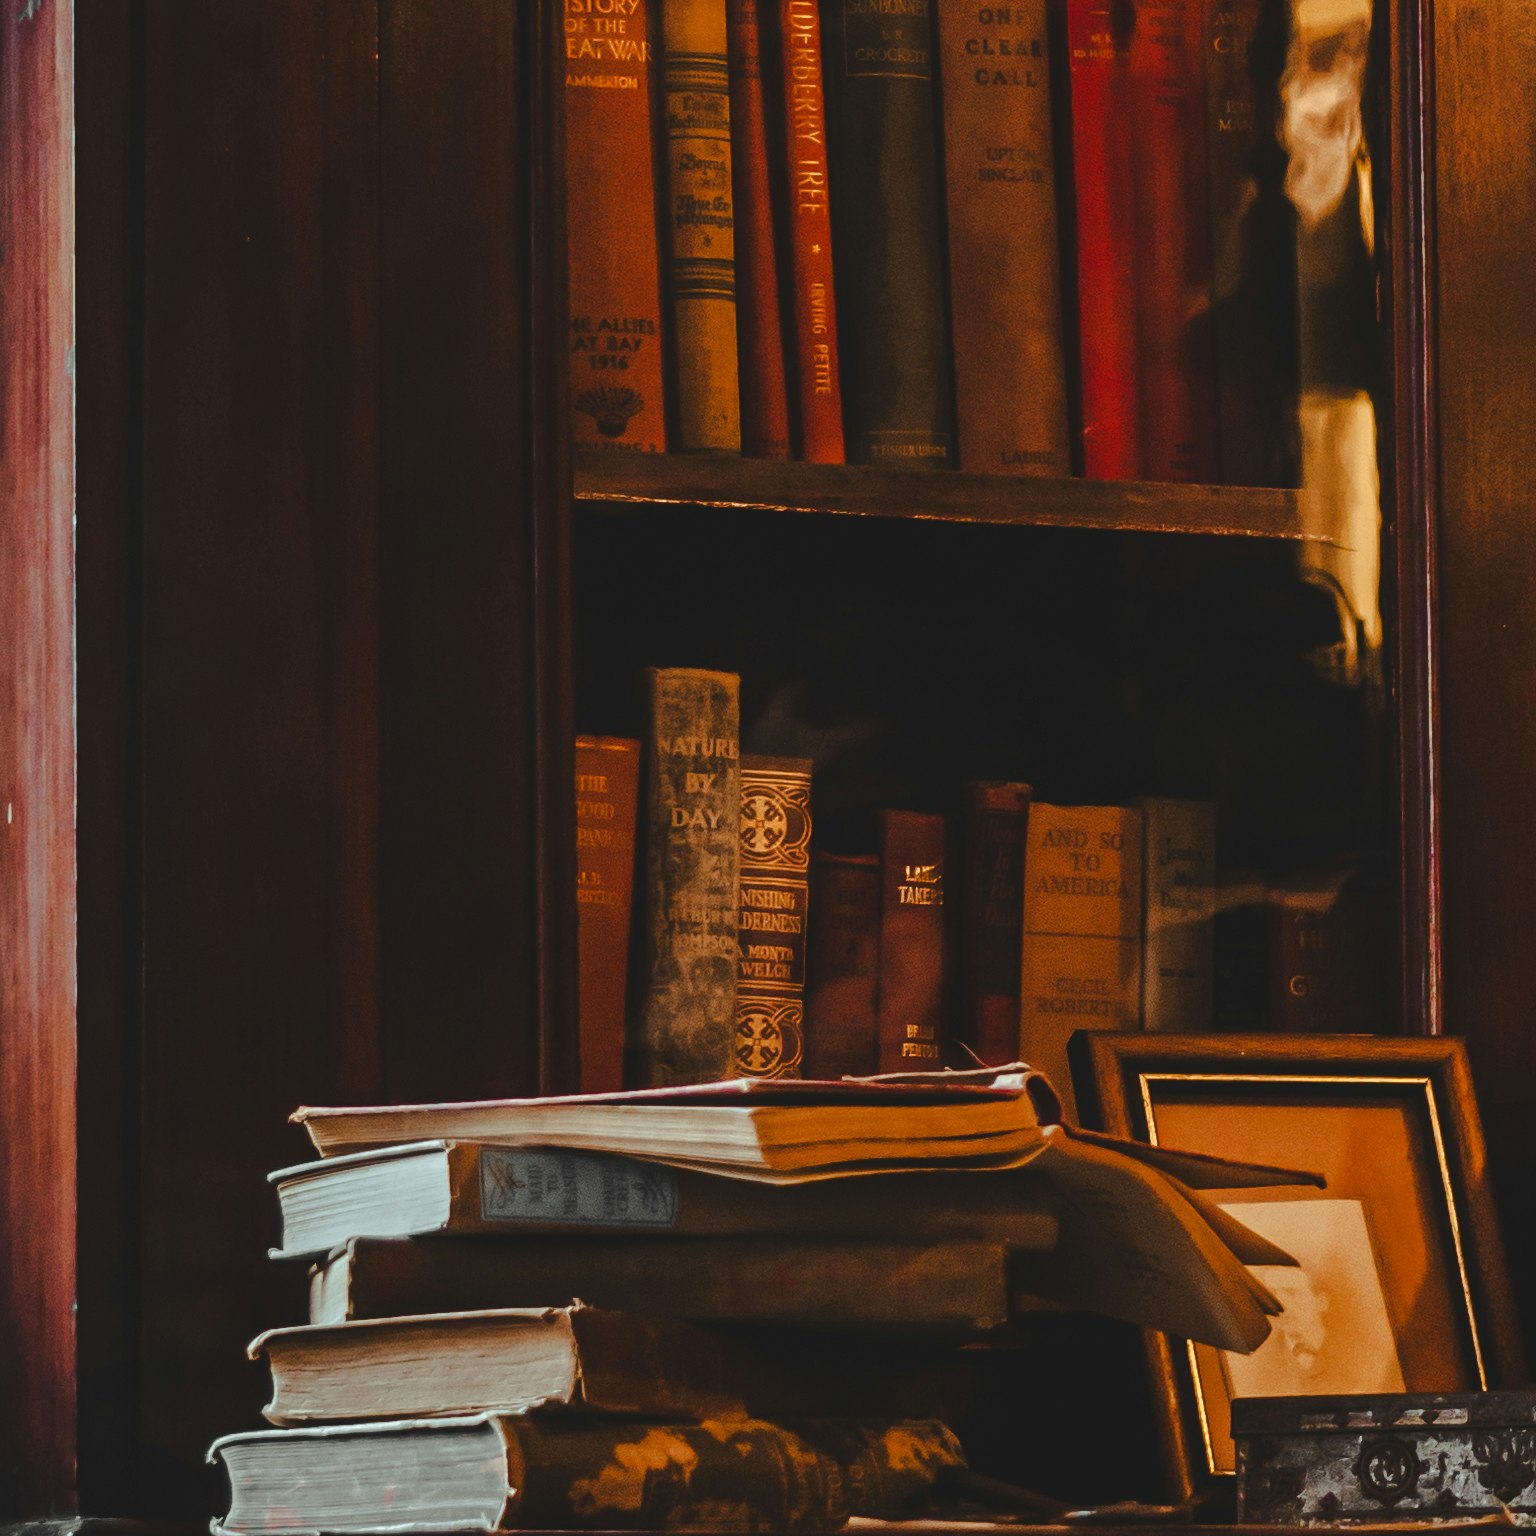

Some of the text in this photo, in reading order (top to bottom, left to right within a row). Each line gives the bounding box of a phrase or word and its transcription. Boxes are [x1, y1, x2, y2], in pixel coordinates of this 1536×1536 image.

[564, 17, 626, 35] OF THE
[978, 8, 1026, 25] ONE
[566, 38, 653, 63] EAT WAR
[854, 47, 928, 64] CROCKETT
[965, 38, 1042, 58] CLEAR
[565, 74, 639, 90] AMMERTON
[974, 68, 1037, 88] CALL
[986, 147, 1036, 162] UPTON
[978, 168, 1044, 183] SINCLAIR
[797, 161, 827, 215] TREE
[597, 318, 655, 334] ALLIES
[572, 336, 643, 353] AT BAY
[809, 282, 832, 395] IRVING PETITE
[588, 354, 629, 371] 1916
[659, 738, 739, 759] NATURE
[577, 775, 608, 793] THE
[685, 772, 717, 793] BY
[671, 809, 722, 829] DAY
[1042, 828, 1088, 848] AND
[1100, 831, 1125, 852] SO
[1069, 853, 1100, 872] TO
[1035, 876, 1131, 899] AMERICA
[740, 889, 796, 910] NISHING
[740, 912, 801, 934] LDERNESS
[741, 962, 791, 979] WELCH
[1055, 977, 1112, 996] CECIL
[1036, 997, 1125, 1018] ROBERTS
[528, 1164, 543, 1204] MAID
[546, 1174, 559, 1193] TO
